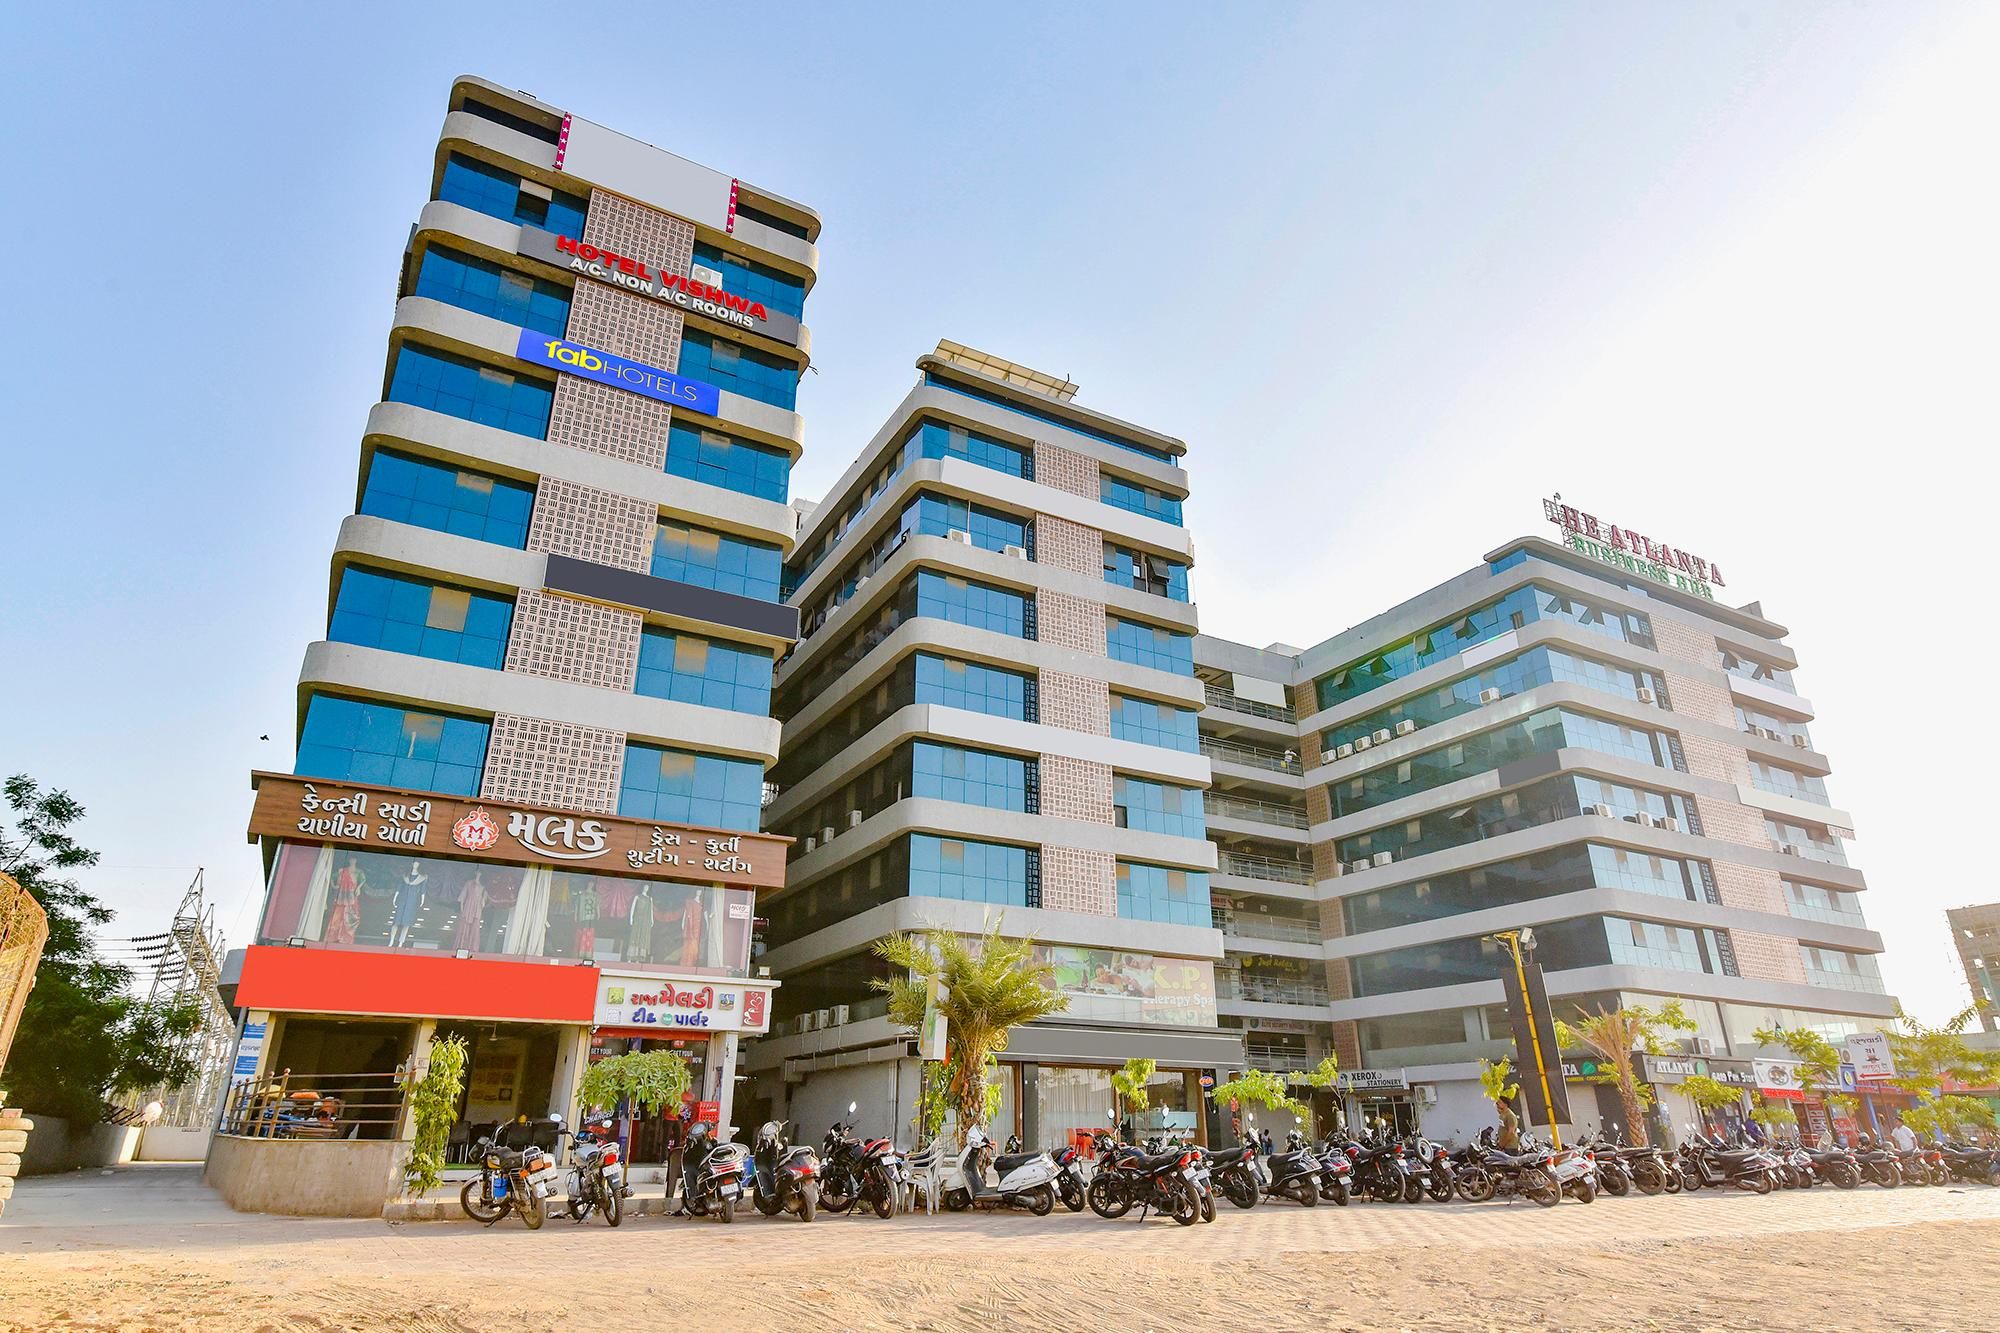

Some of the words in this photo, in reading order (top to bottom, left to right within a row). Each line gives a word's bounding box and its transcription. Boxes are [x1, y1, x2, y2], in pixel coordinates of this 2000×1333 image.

[556, 235, 653, 279] HOTEL
[659, 269, 767, 321] VISHWA
[612, 270, 653, 292] NON
[657, 286, 687, 306] A/C
[692, 298, 754, 328] ROOMS
[1543, 498, 1601, 540] THE
[1610, 524, 1726, 587] ATLANTA
[1572, 534, 1670, 584] BUSINESS
[1675, 573, 1713, 600] HUB
[297, 813, 368, 839] ચણીયા
[377, 818, 427, 846] ચોળી
[378, 800, 431, 823] સાડી
[468, 825, 485, 840] M
[507, 812, 609, 852] મલક
[1352, 1072, 1377, 1081] XEROX
[1656, 1061, 1695, 1075] ATLANTA
